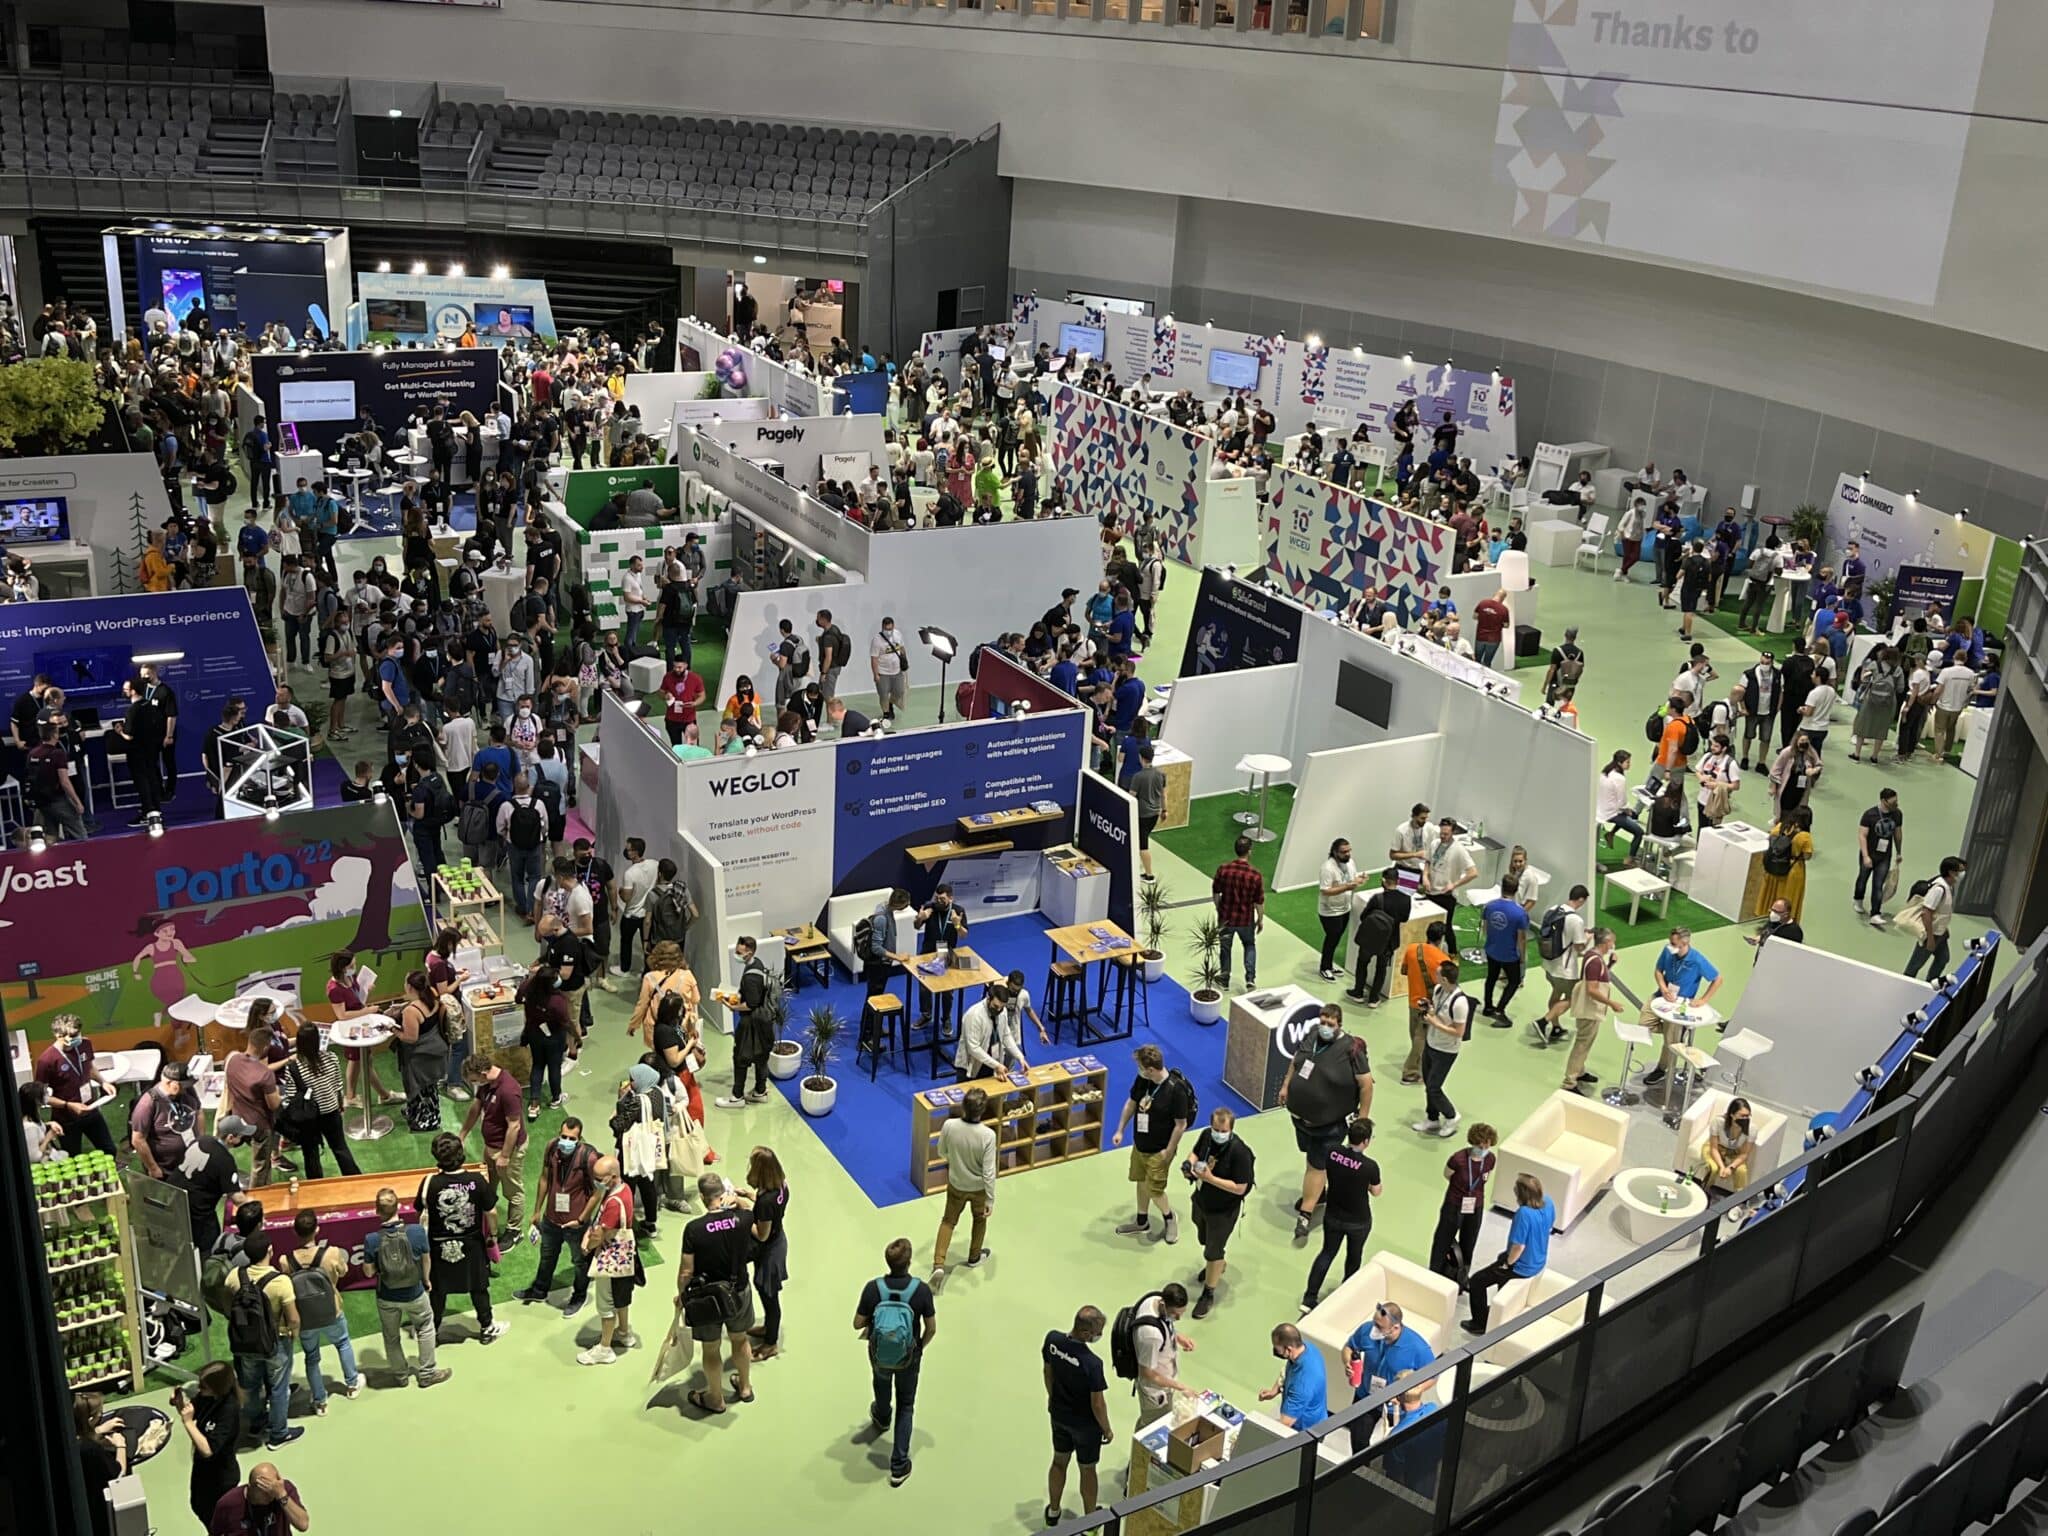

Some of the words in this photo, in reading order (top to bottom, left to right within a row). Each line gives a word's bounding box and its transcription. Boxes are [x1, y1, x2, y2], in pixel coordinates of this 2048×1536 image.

[1590, 12, 1714, 52] Thanks
[1724, 20, 1760, 56] to
[382, 362, 400, 370] Fully
[401, 361, 438, 370] Managed
[440, 360, 446, 368] &
[447, 359, 475, 367] Flexible
[400, 381, 445, 390] Multi-Cloud
[446, 380, 475, 389] Hosting
[403, 391, 416, 399] For
[416, 390, 457, 399] WordPress
[756, 425, 805, 443] Pagely
[833, 455, 857, 465] Pagely
[8, 479, 21, 487] for
[22, 479, 60, 487] Creators
[1292, 509, 1310, 534] 10
[25, 622, 93, 638] Improving
[95, 617, 167, 631] WordPress
[169, 609, 241, 626] Experience
[987, 737, 1024, 750] Automatic
[1024, 731, 1067, 744] translations
[870, 756, 887, 766] Add
[888, 755, 903, 764] new
[904, 749, 943, 762] languages
[986, 751, 1003, 760] with
[1003, 746, 1028, 759] editing
[1028, 742, 1056, 756] options
[870, 768, 878, 776] in
[879, 765, 909, 775] minutes
[708, 768, 801, 798] WEGLOT
[984, 790, 993, 799] all
[994, 786, 1020, 799] plugins
[1021, 785, 1027, 793] &
[1027, 782, 1054, 793] themes
[985, 777, 1026, 790] Compatible
[1026, 774, 1042, 783] with
[868, 808, 885, 817] with
[886, 801, 931, 816] multilingual
[930, 798, 947, 807] SEO
[869, 797, 884, 807] Get
[884, 796, 904, 804] more
[903, 791, 928, 801] traffic
[709, 817, 749, 831] Translate
[750, 814, 770, 826] your
[771, 807, 818, 821] WordPress
[1088, 809, 1128, 845] WEGLOT
[746, 824, 780, 837] without
[780, 820, 802, 831] code
[154, 852, 306, 911] Porto.
[85, 969, 120, 984] ONLINE
[1329, 1151, 1363, 1171] CREW
